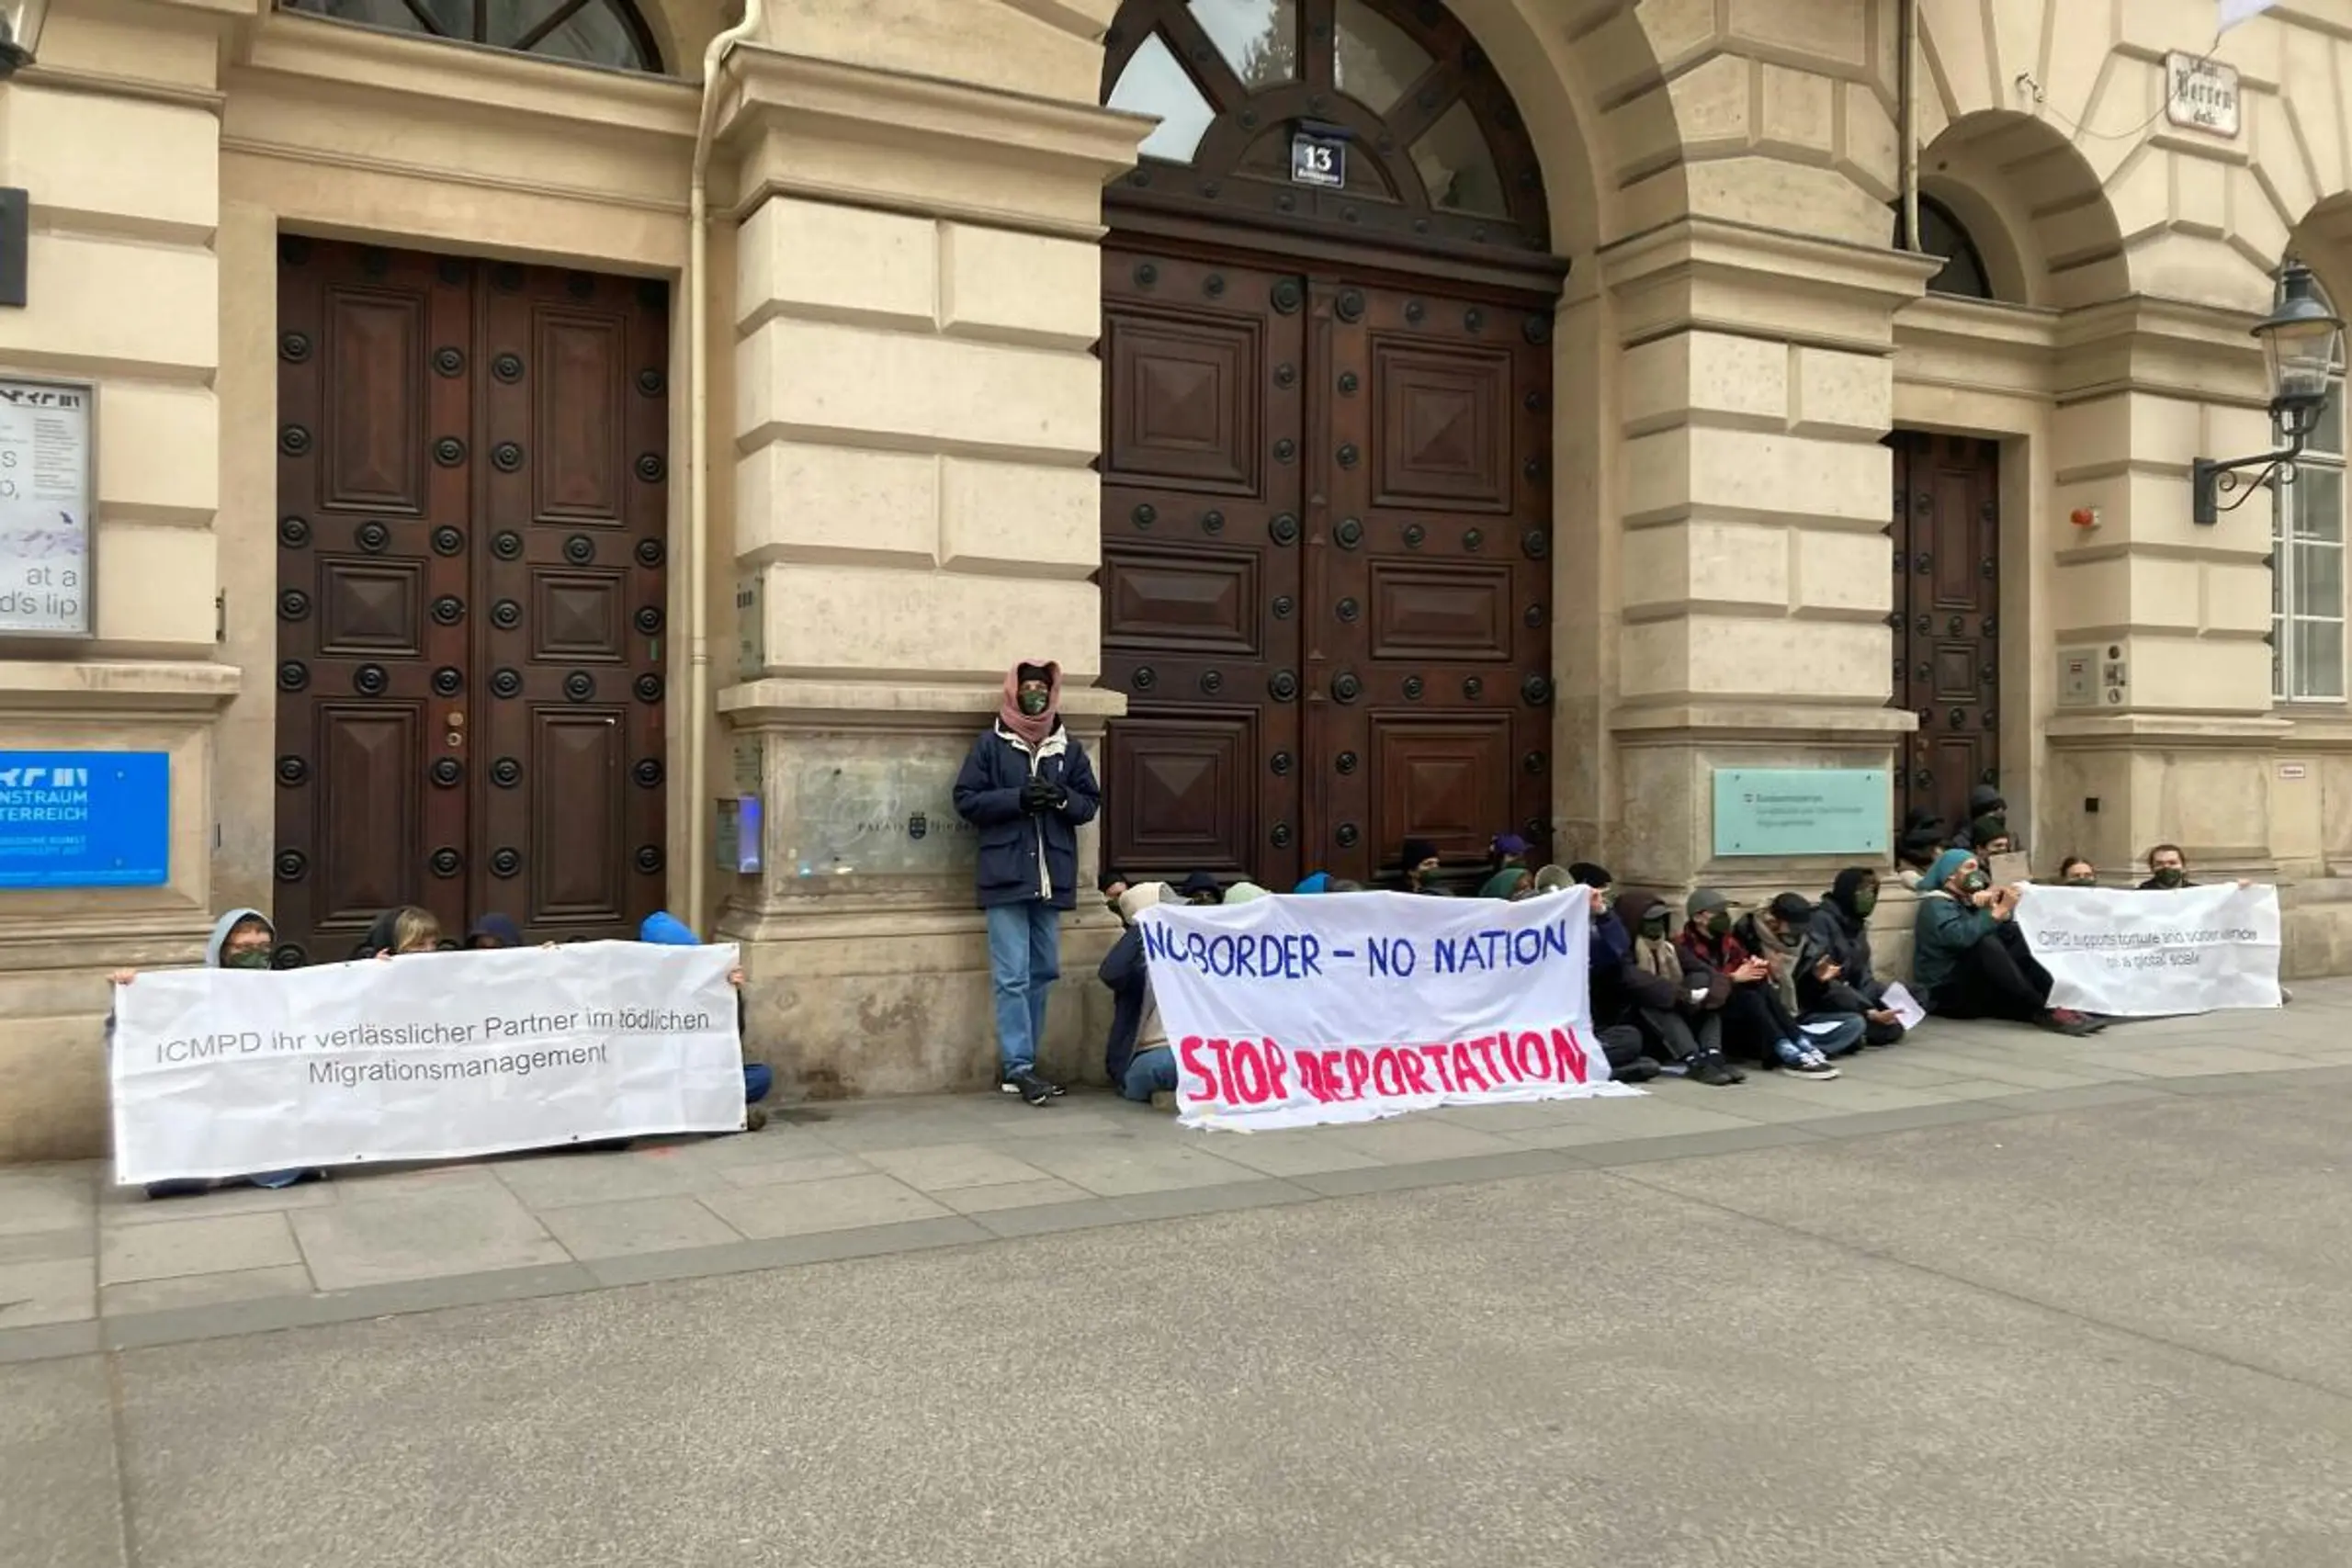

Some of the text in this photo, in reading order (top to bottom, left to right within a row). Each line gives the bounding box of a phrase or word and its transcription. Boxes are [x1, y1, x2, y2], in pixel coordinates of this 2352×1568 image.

[1304, 145, 1333, 173] 13
[27, 565, 77, 588] at a
[46, 593, 78, 620] lip
[1186, 931, 1322, 979] BORDER
[1368, 936, 1416, 977] NO
[1434, 919, 1567, 974] NATION
[156, 1031, 262, 1064] ICMPD
[314, 1021, 477, 1048] verlässlicher
[484, 1012, 579, 1039] Partner
[586, 1007, 614, 1028] im
[618, 1006, 710, 1031] tödlichen
[308, 1042, 608, 1089] Migrationsmanagement
[1180, 1027, 1588, 1105] STOP DEPORTATION
